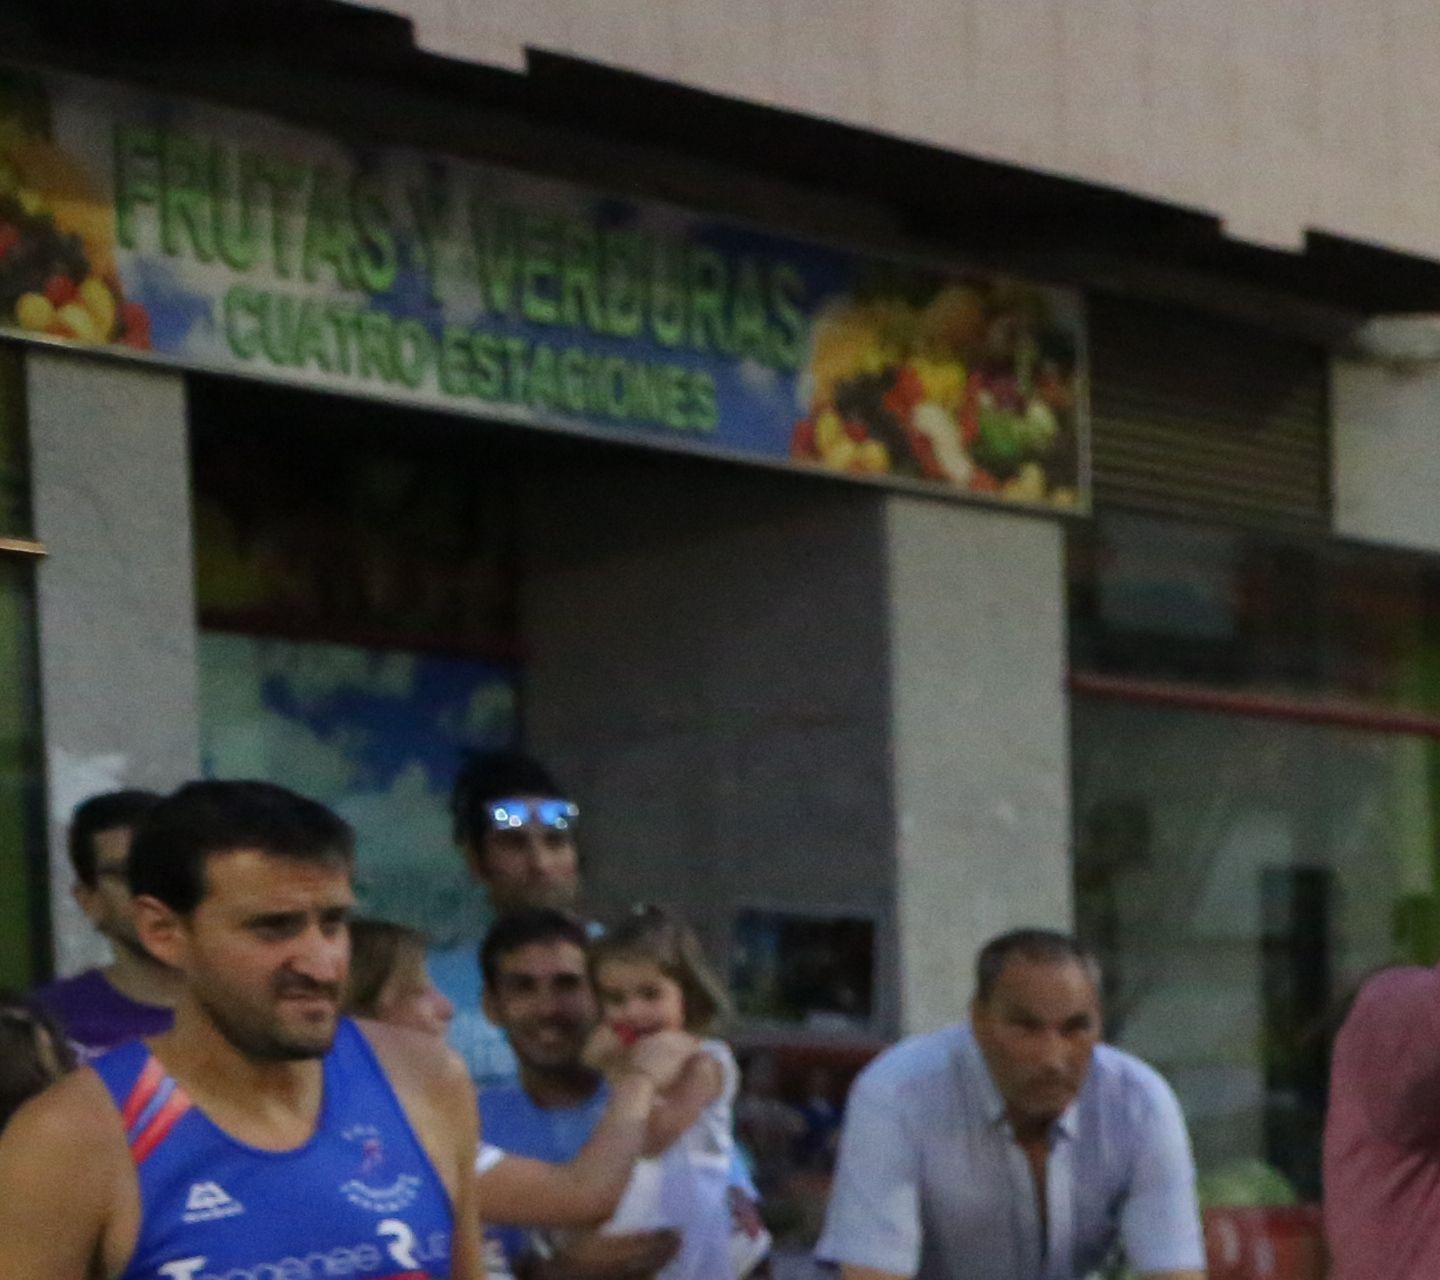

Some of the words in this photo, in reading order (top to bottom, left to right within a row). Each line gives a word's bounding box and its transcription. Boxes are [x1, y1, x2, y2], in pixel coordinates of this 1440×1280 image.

[113, 122, 397, 293] FRUTAS
[410, 158, 452, 306] Y
[470, 195, 805, 369] VERDURAS
[222, 285, 436, 389] CUATRO
[437, 324, 719, 434] ESTACIONES
